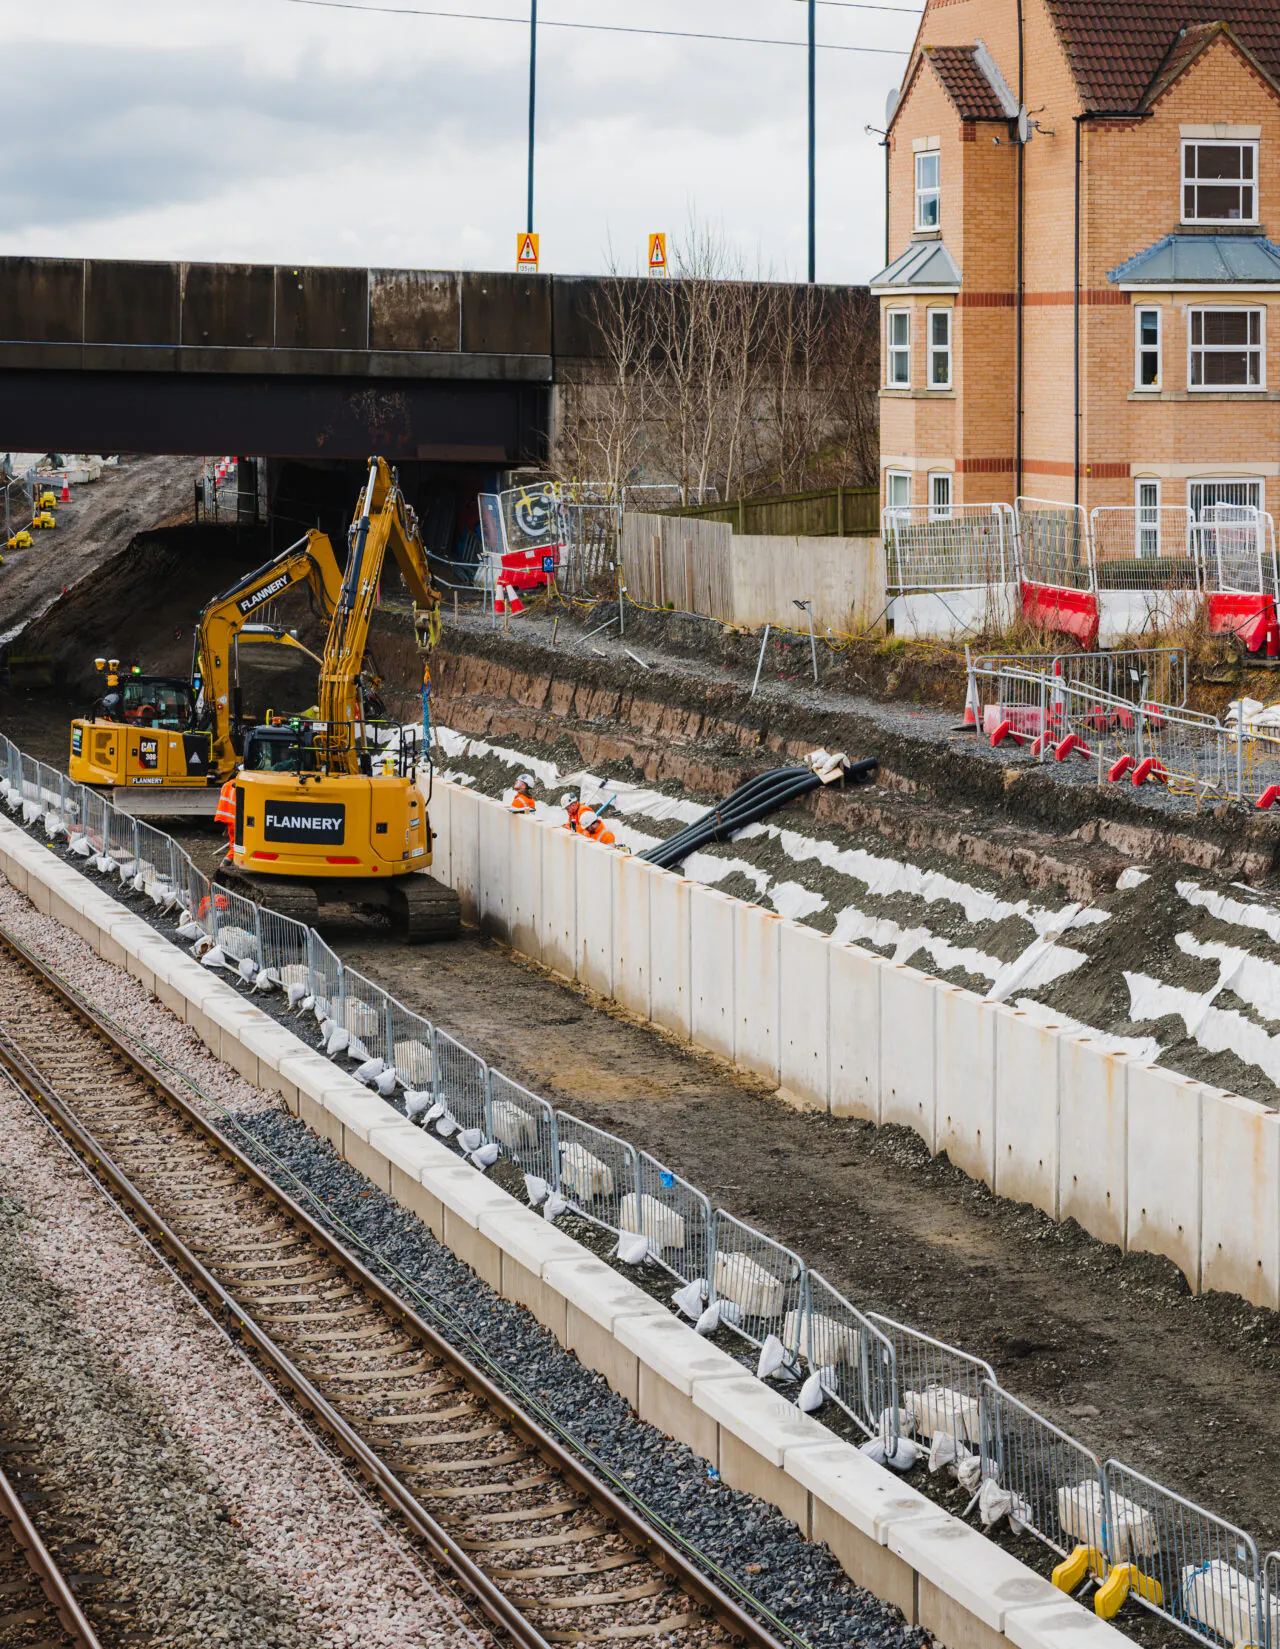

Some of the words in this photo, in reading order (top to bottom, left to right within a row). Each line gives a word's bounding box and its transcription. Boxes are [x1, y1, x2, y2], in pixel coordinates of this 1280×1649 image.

[241, 575, 288, 611] FLANNERY
[141, 742, 156, 752] CAT
[266, 815, 342, 830] FLANNERY
